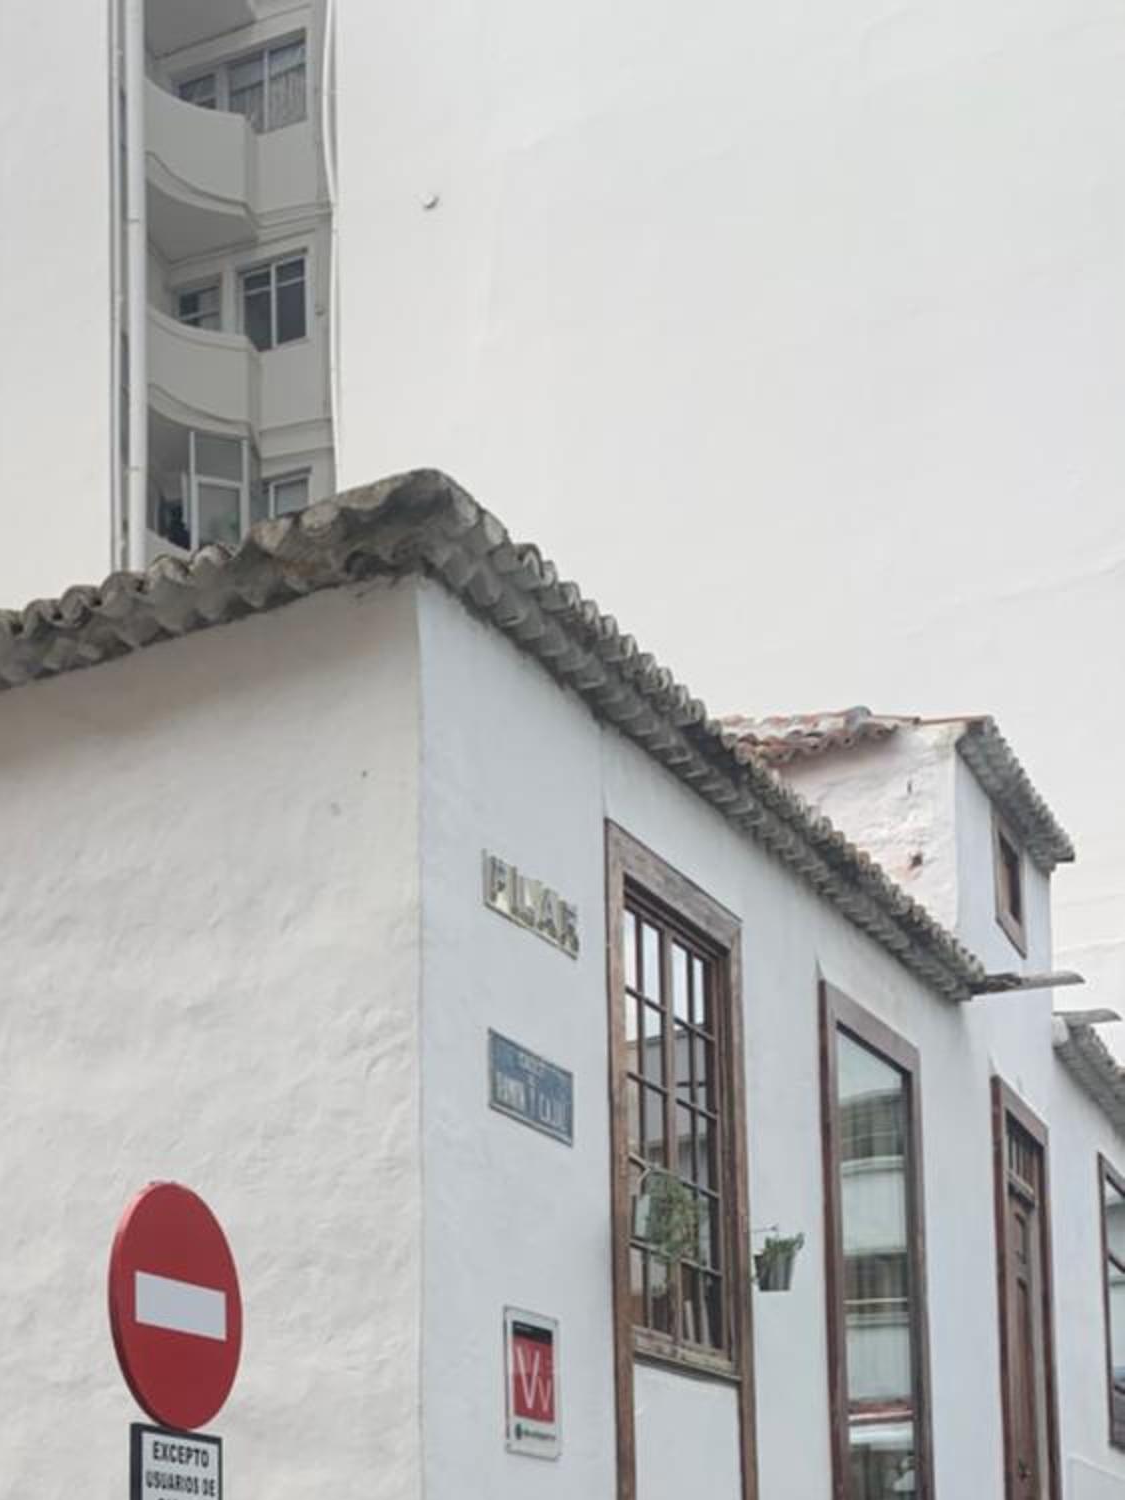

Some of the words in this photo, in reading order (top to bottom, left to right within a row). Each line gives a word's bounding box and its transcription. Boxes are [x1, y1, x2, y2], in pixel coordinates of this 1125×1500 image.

[153, 1441, 210, 1468] EXCEPTO
[146, 1470, 200, 1495] USUARIOS
[202, 1477, 217, 1498] DE
